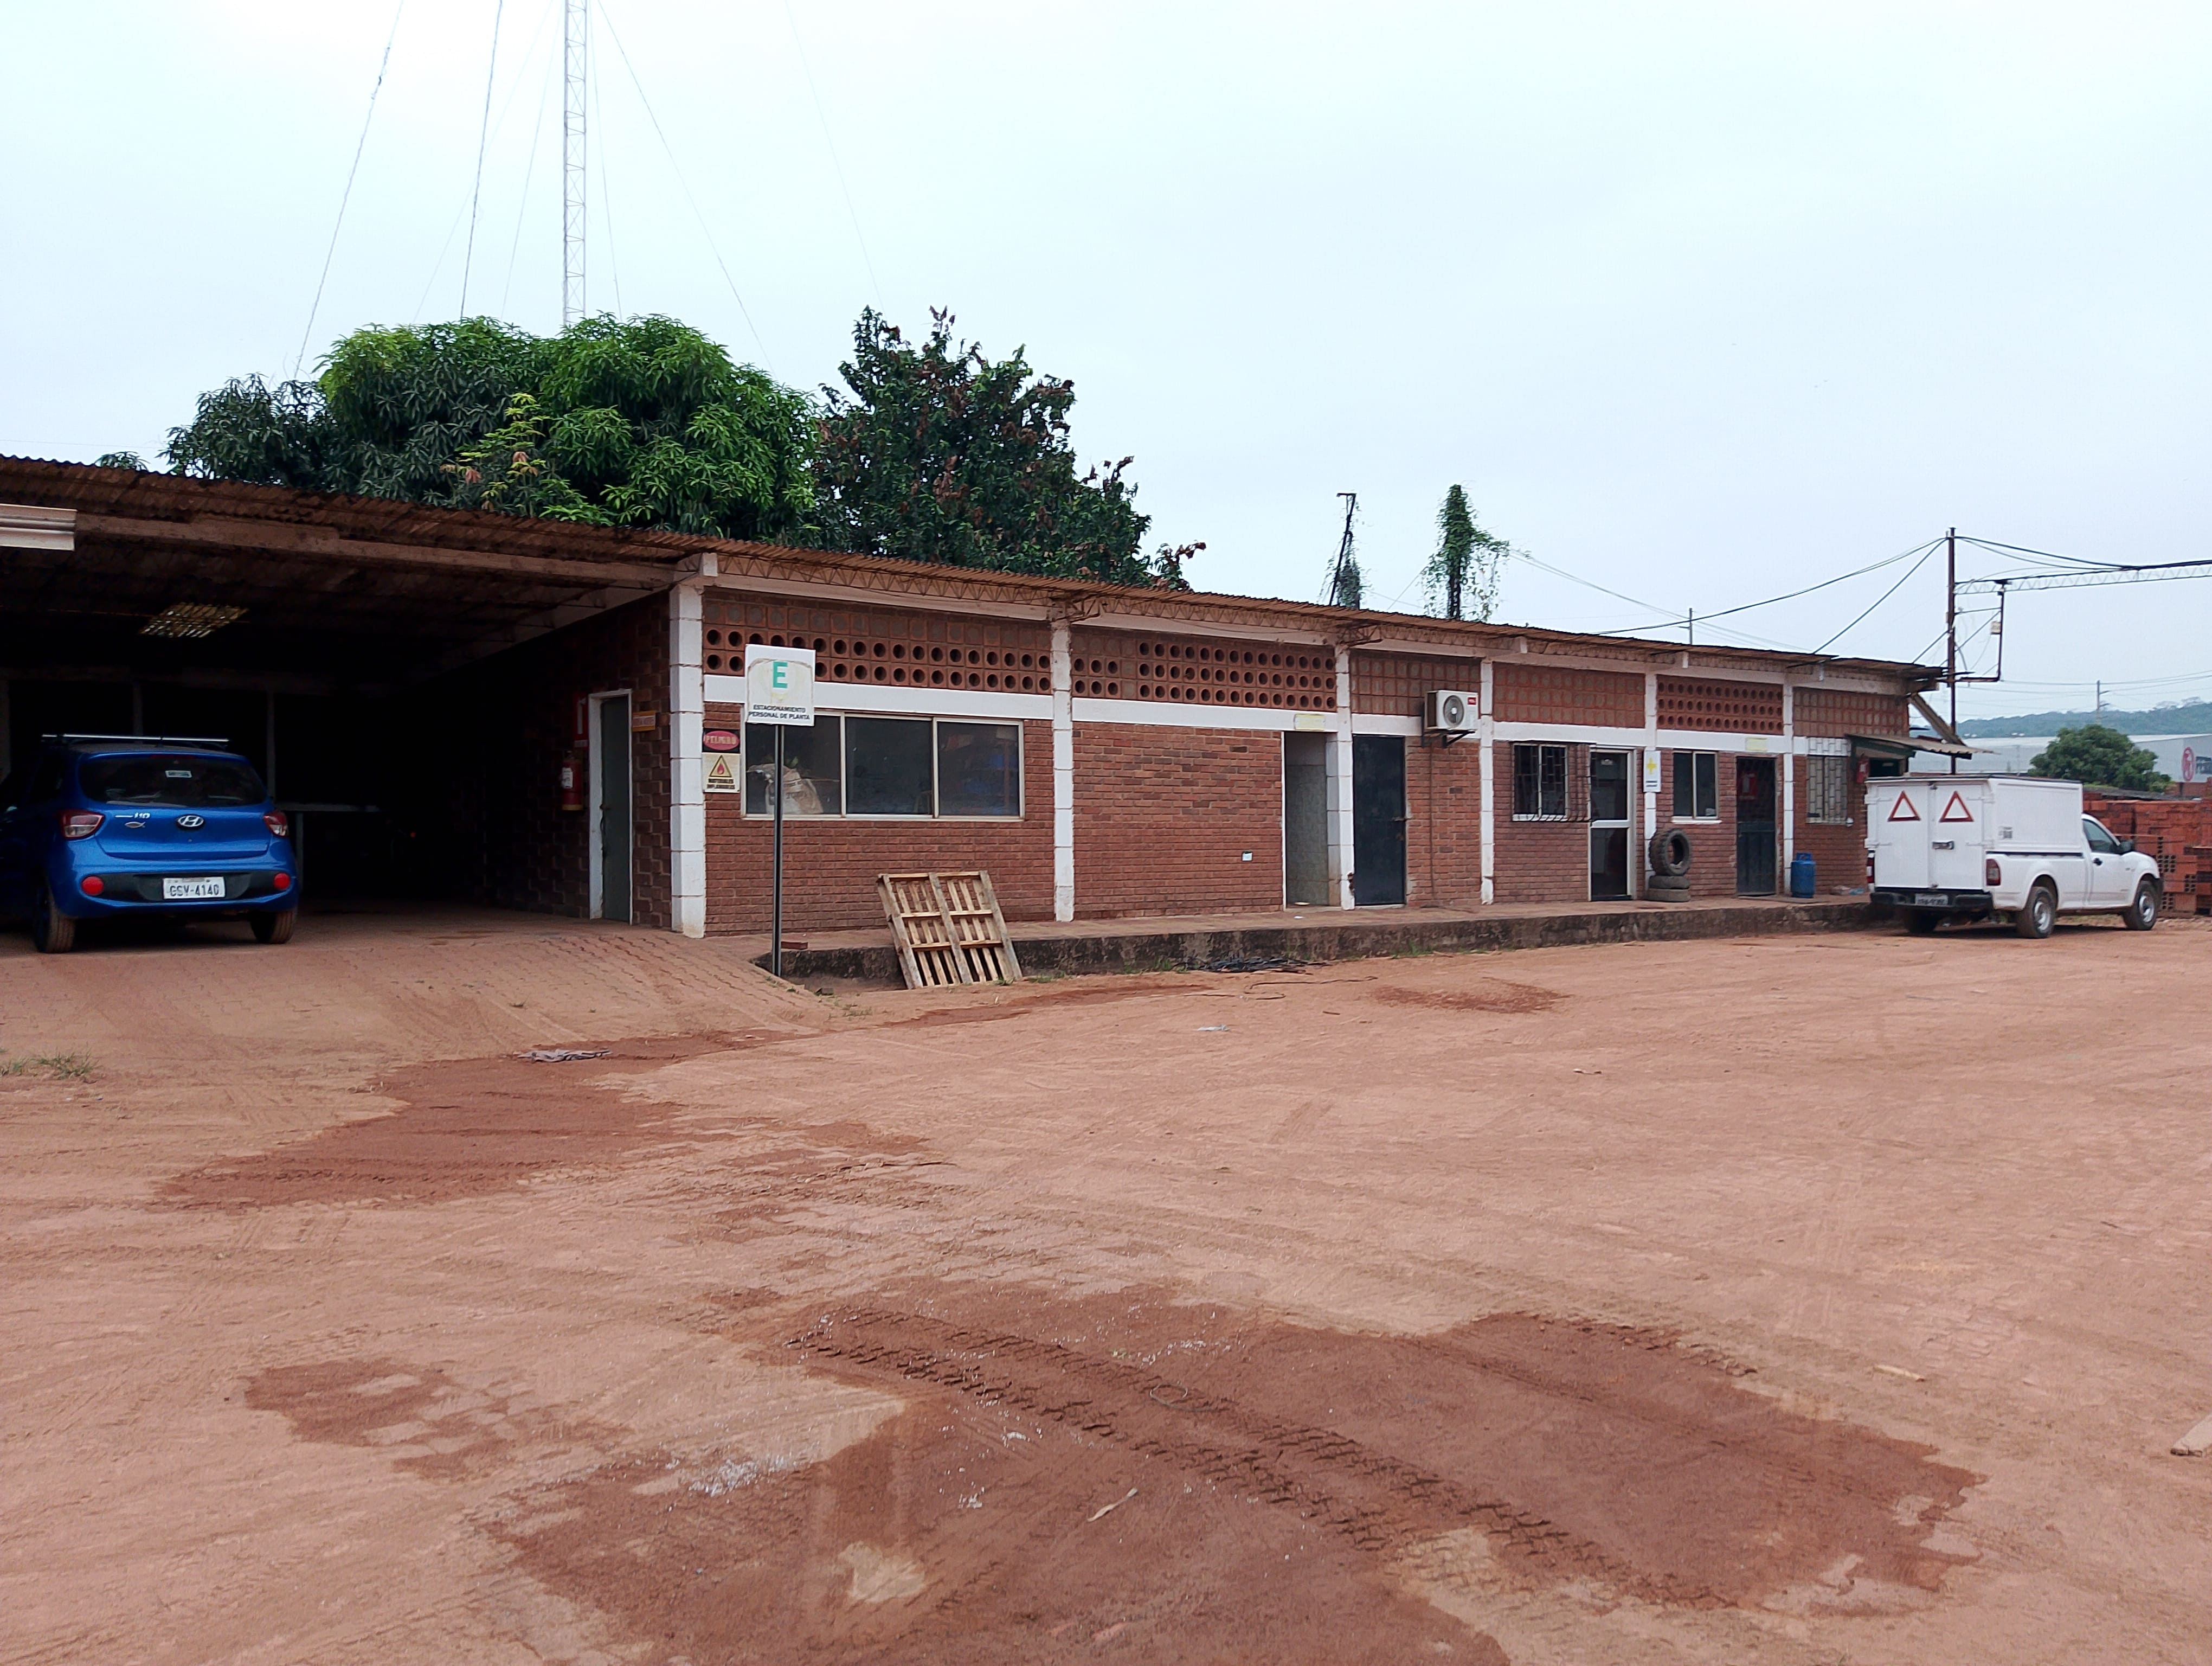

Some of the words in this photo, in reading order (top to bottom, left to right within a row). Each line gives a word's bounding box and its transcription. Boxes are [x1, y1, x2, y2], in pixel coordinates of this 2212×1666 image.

[772, 661, 788, 689] E
[753, 704, 806, 713] ESTACIONAMIENTO
[706, 735, 736, 745] PELIGRO
